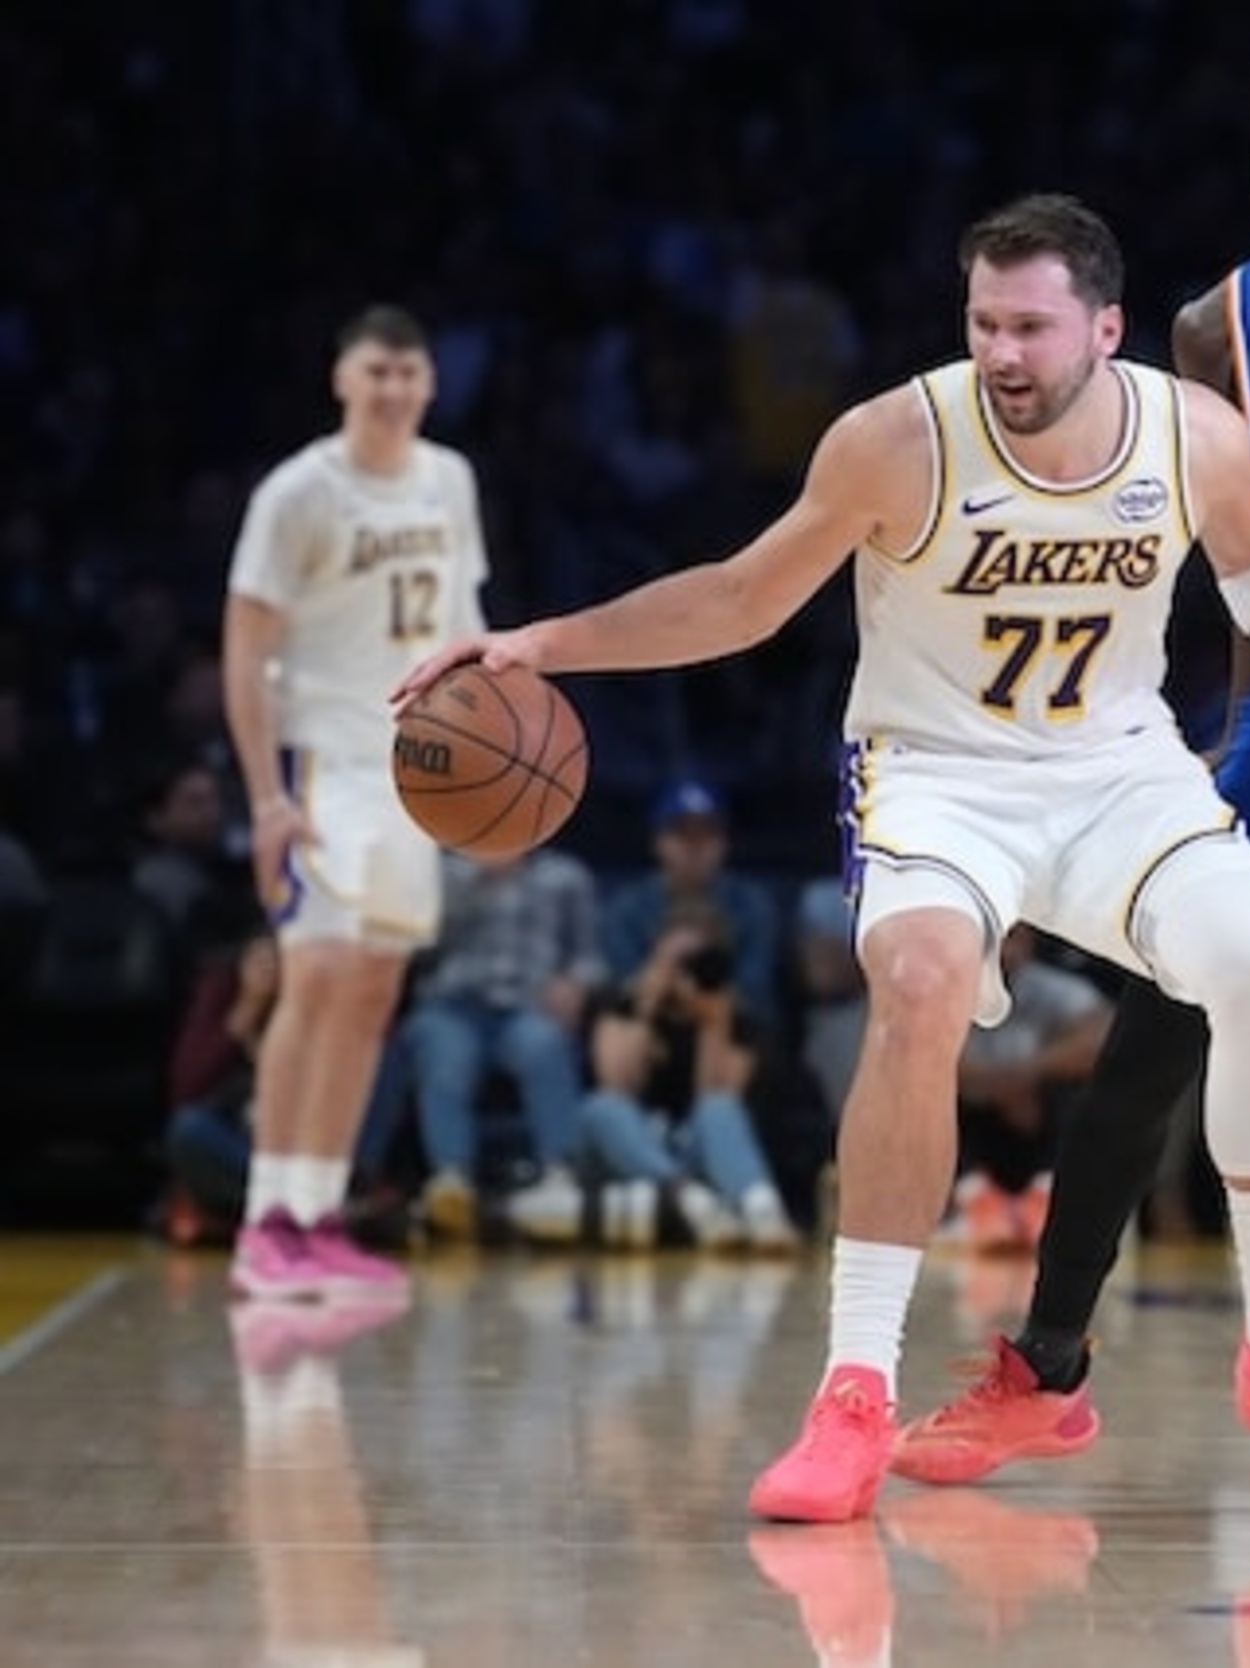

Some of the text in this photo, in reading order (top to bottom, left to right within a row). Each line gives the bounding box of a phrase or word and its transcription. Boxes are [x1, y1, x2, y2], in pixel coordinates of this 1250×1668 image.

[943, 529, 1162, 595] LAKERS
[388, 570, 440, 642] 12
[980, 613, 1113, 720] 77
